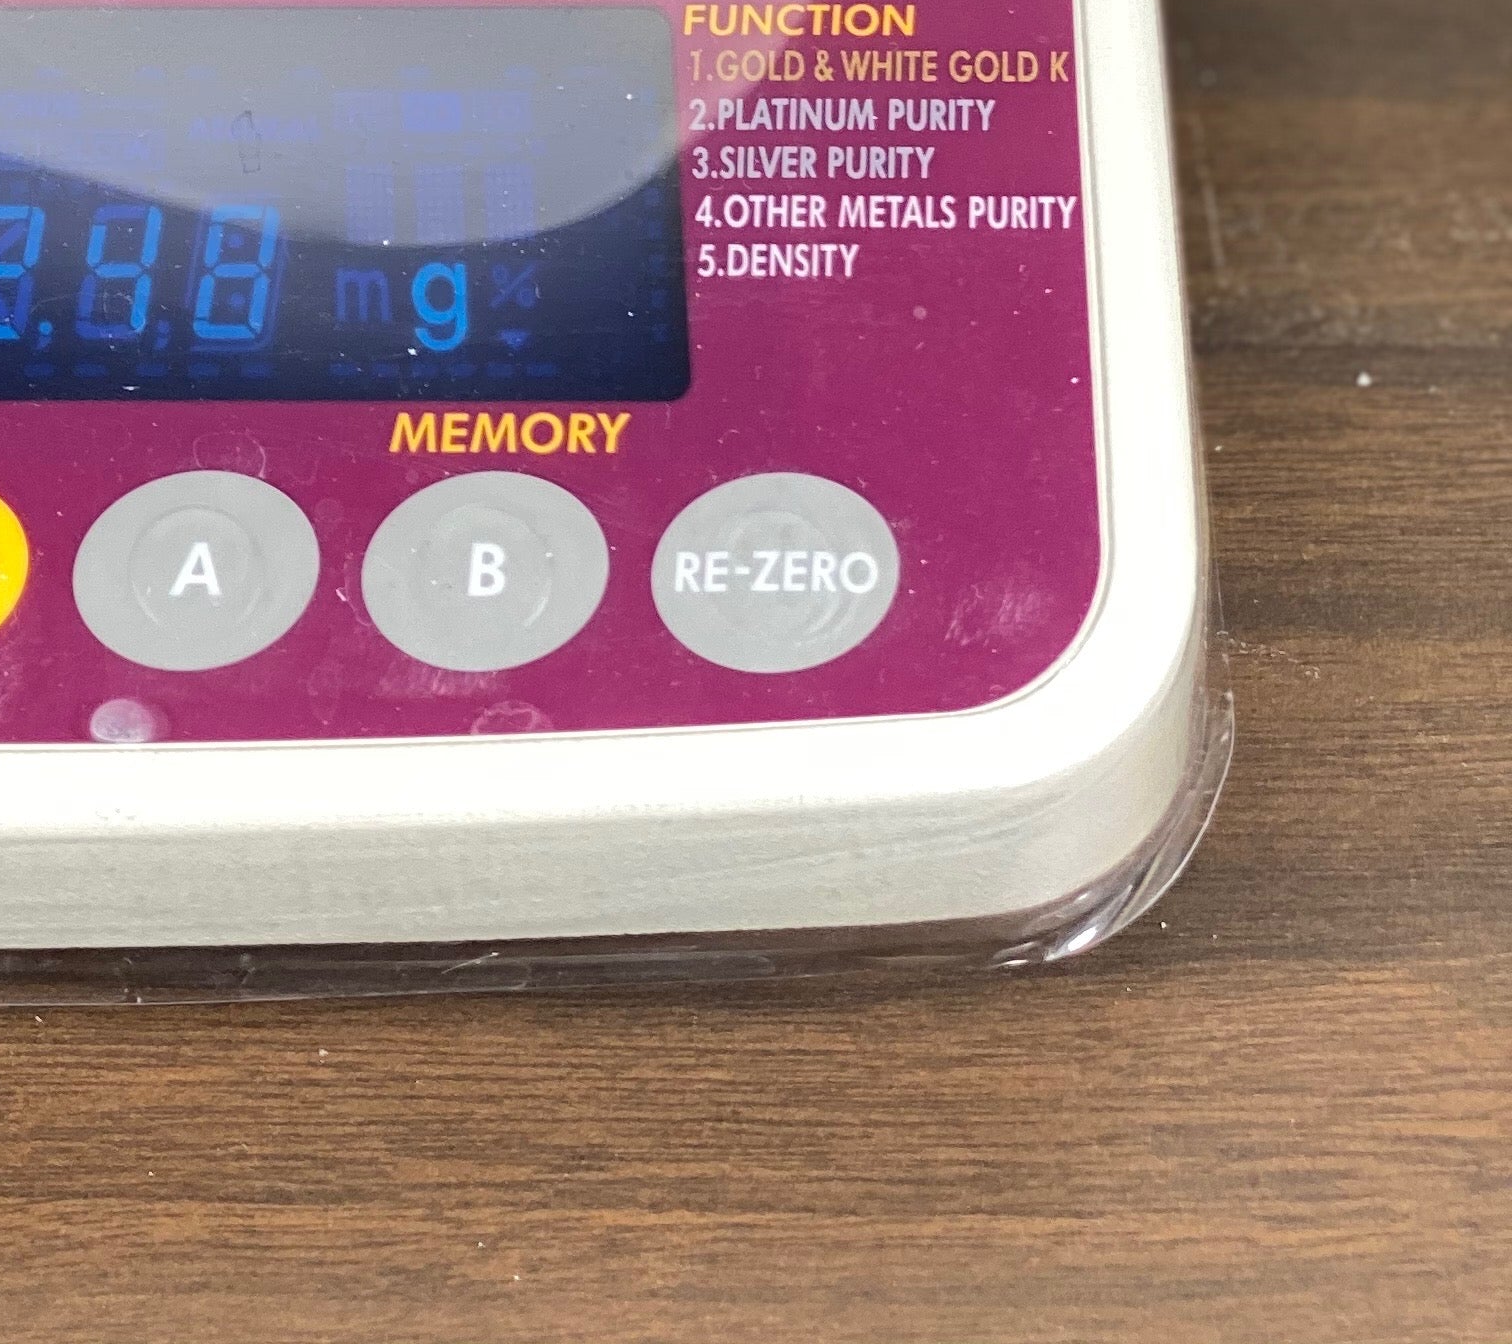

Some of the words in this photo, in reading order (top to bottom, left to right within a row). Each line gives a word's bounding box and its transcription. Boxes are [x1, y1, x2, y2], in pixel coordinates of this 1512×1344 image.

[682, 3, 916, 37] FUNCTION
[690, 51, 805, 83] 1.GOLD
[815, 51, 833, 82] &
[841, 50, 937, 82] WHITE
[948, 50, 1039, 82] GOLD
[689, 99, 877, 132] 2.PLATINUM
[887, 98, 996, 131] PURITY
[691, 147, 818, 181] 3.SILVER
[826, 146, 935, 180] PURITY
[694, 194, 827, 230] 4.OTHER
[838, 195, 957, 229] METALS
[968, 196, 1078, 228] PURITY
[697, 243, 859, 278] 5.DENSITY
[388, 413, 631, 455] MEMORY
[169, 542, 222, 597] A
[467, 544, 506, 597] B
[675, 552, 878, 595] RE-ZERO
